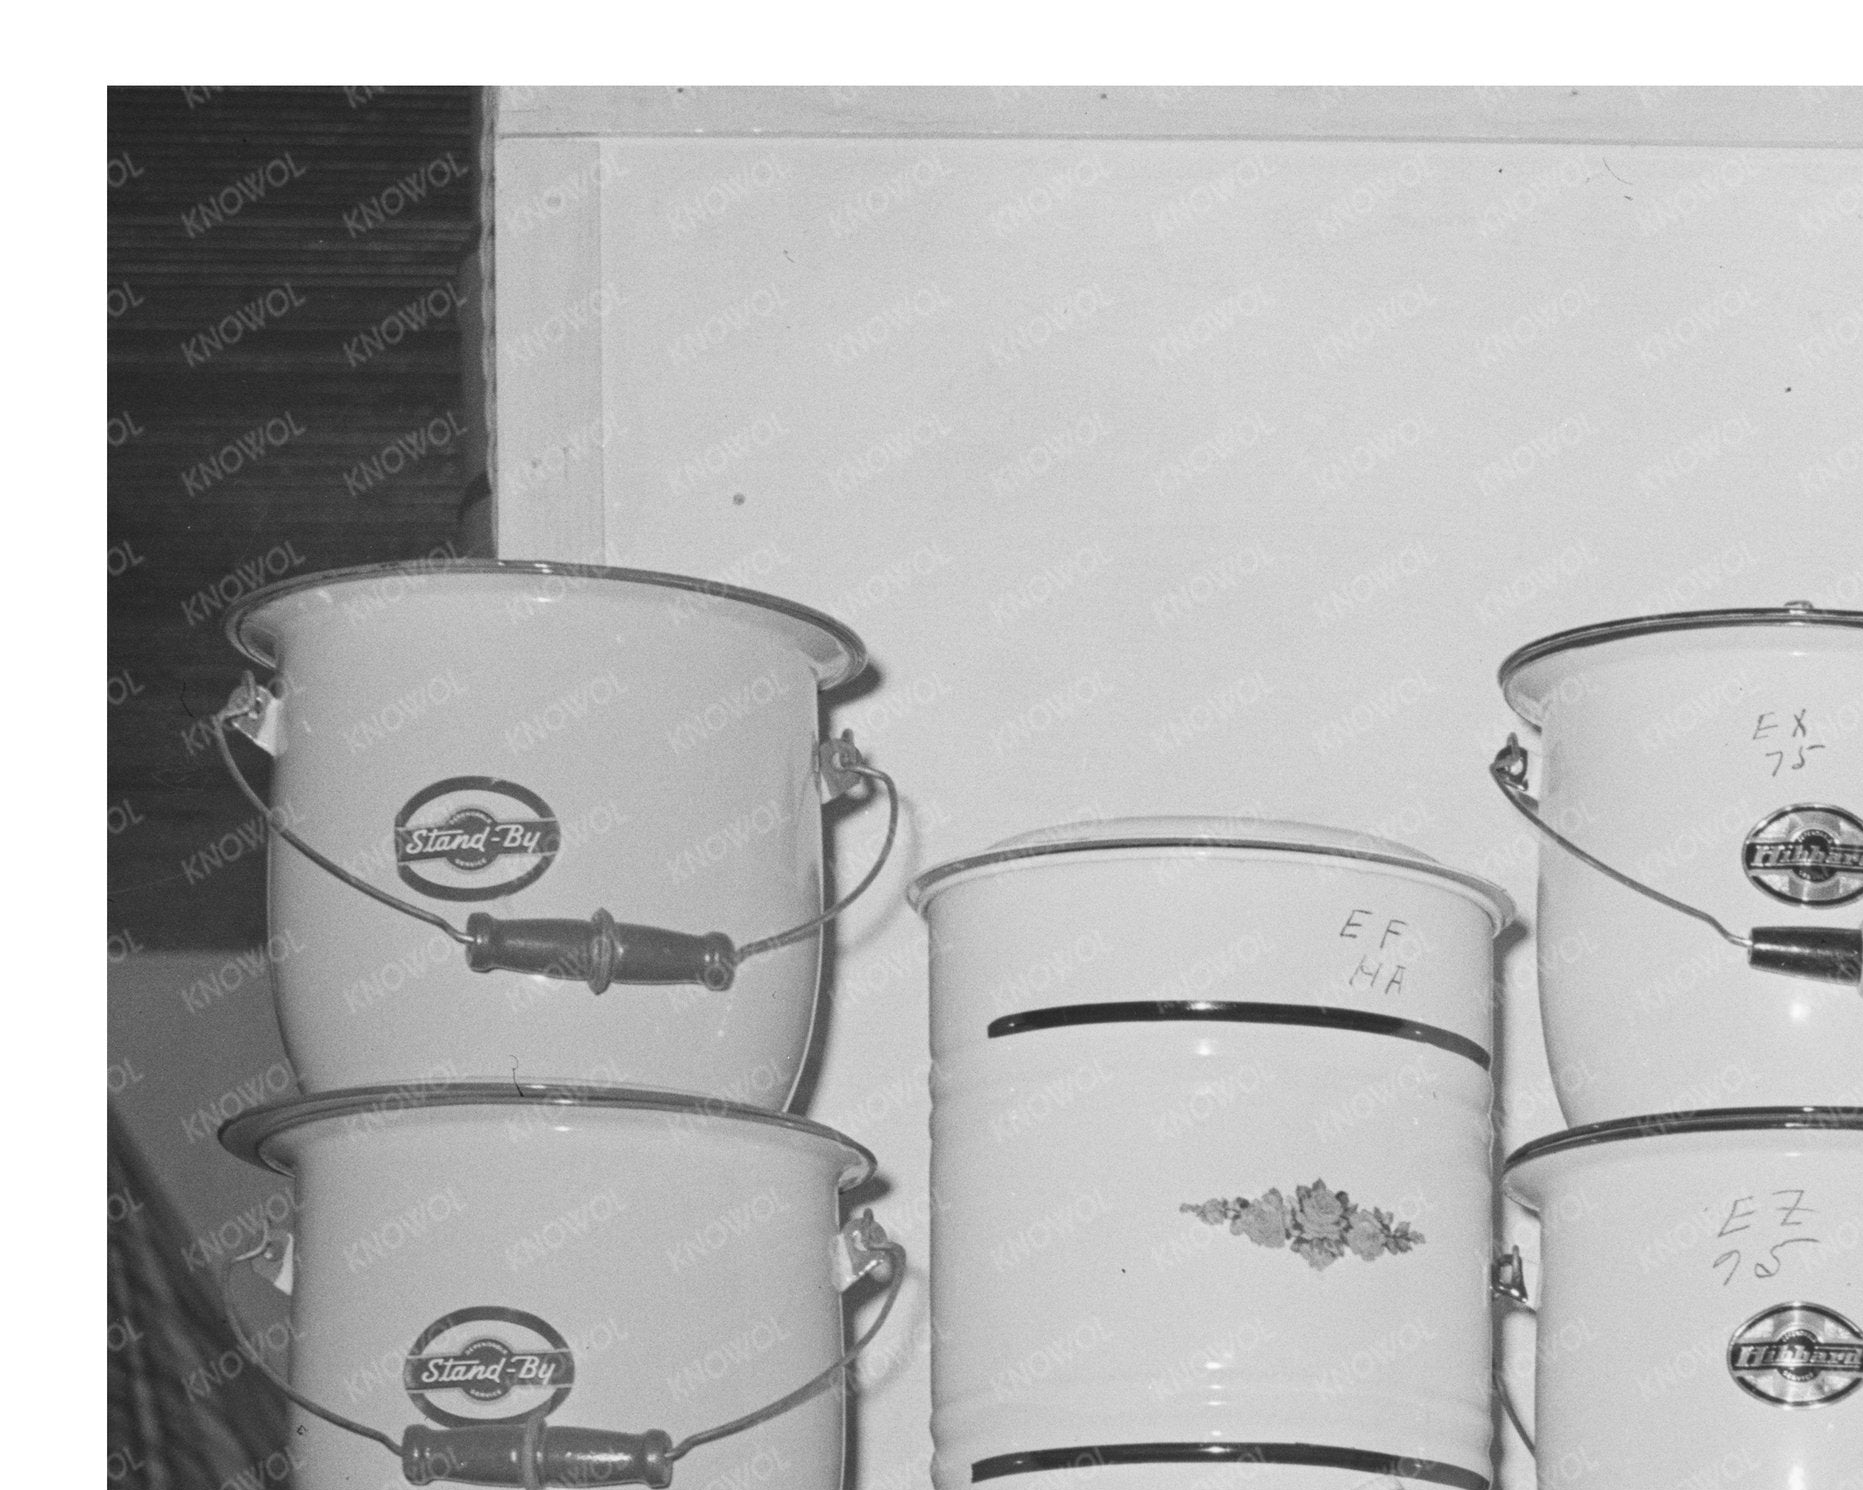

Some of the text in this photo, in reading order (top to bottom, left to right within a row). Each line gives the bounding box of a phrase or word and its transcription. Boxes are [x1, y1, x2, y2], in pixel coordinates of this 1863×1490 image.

[405, 824, 541, 854] Stand-By
[419, 1349, 557, 1389] Stand-By
[1738, 1344, 1863, 1370] Hibbard
